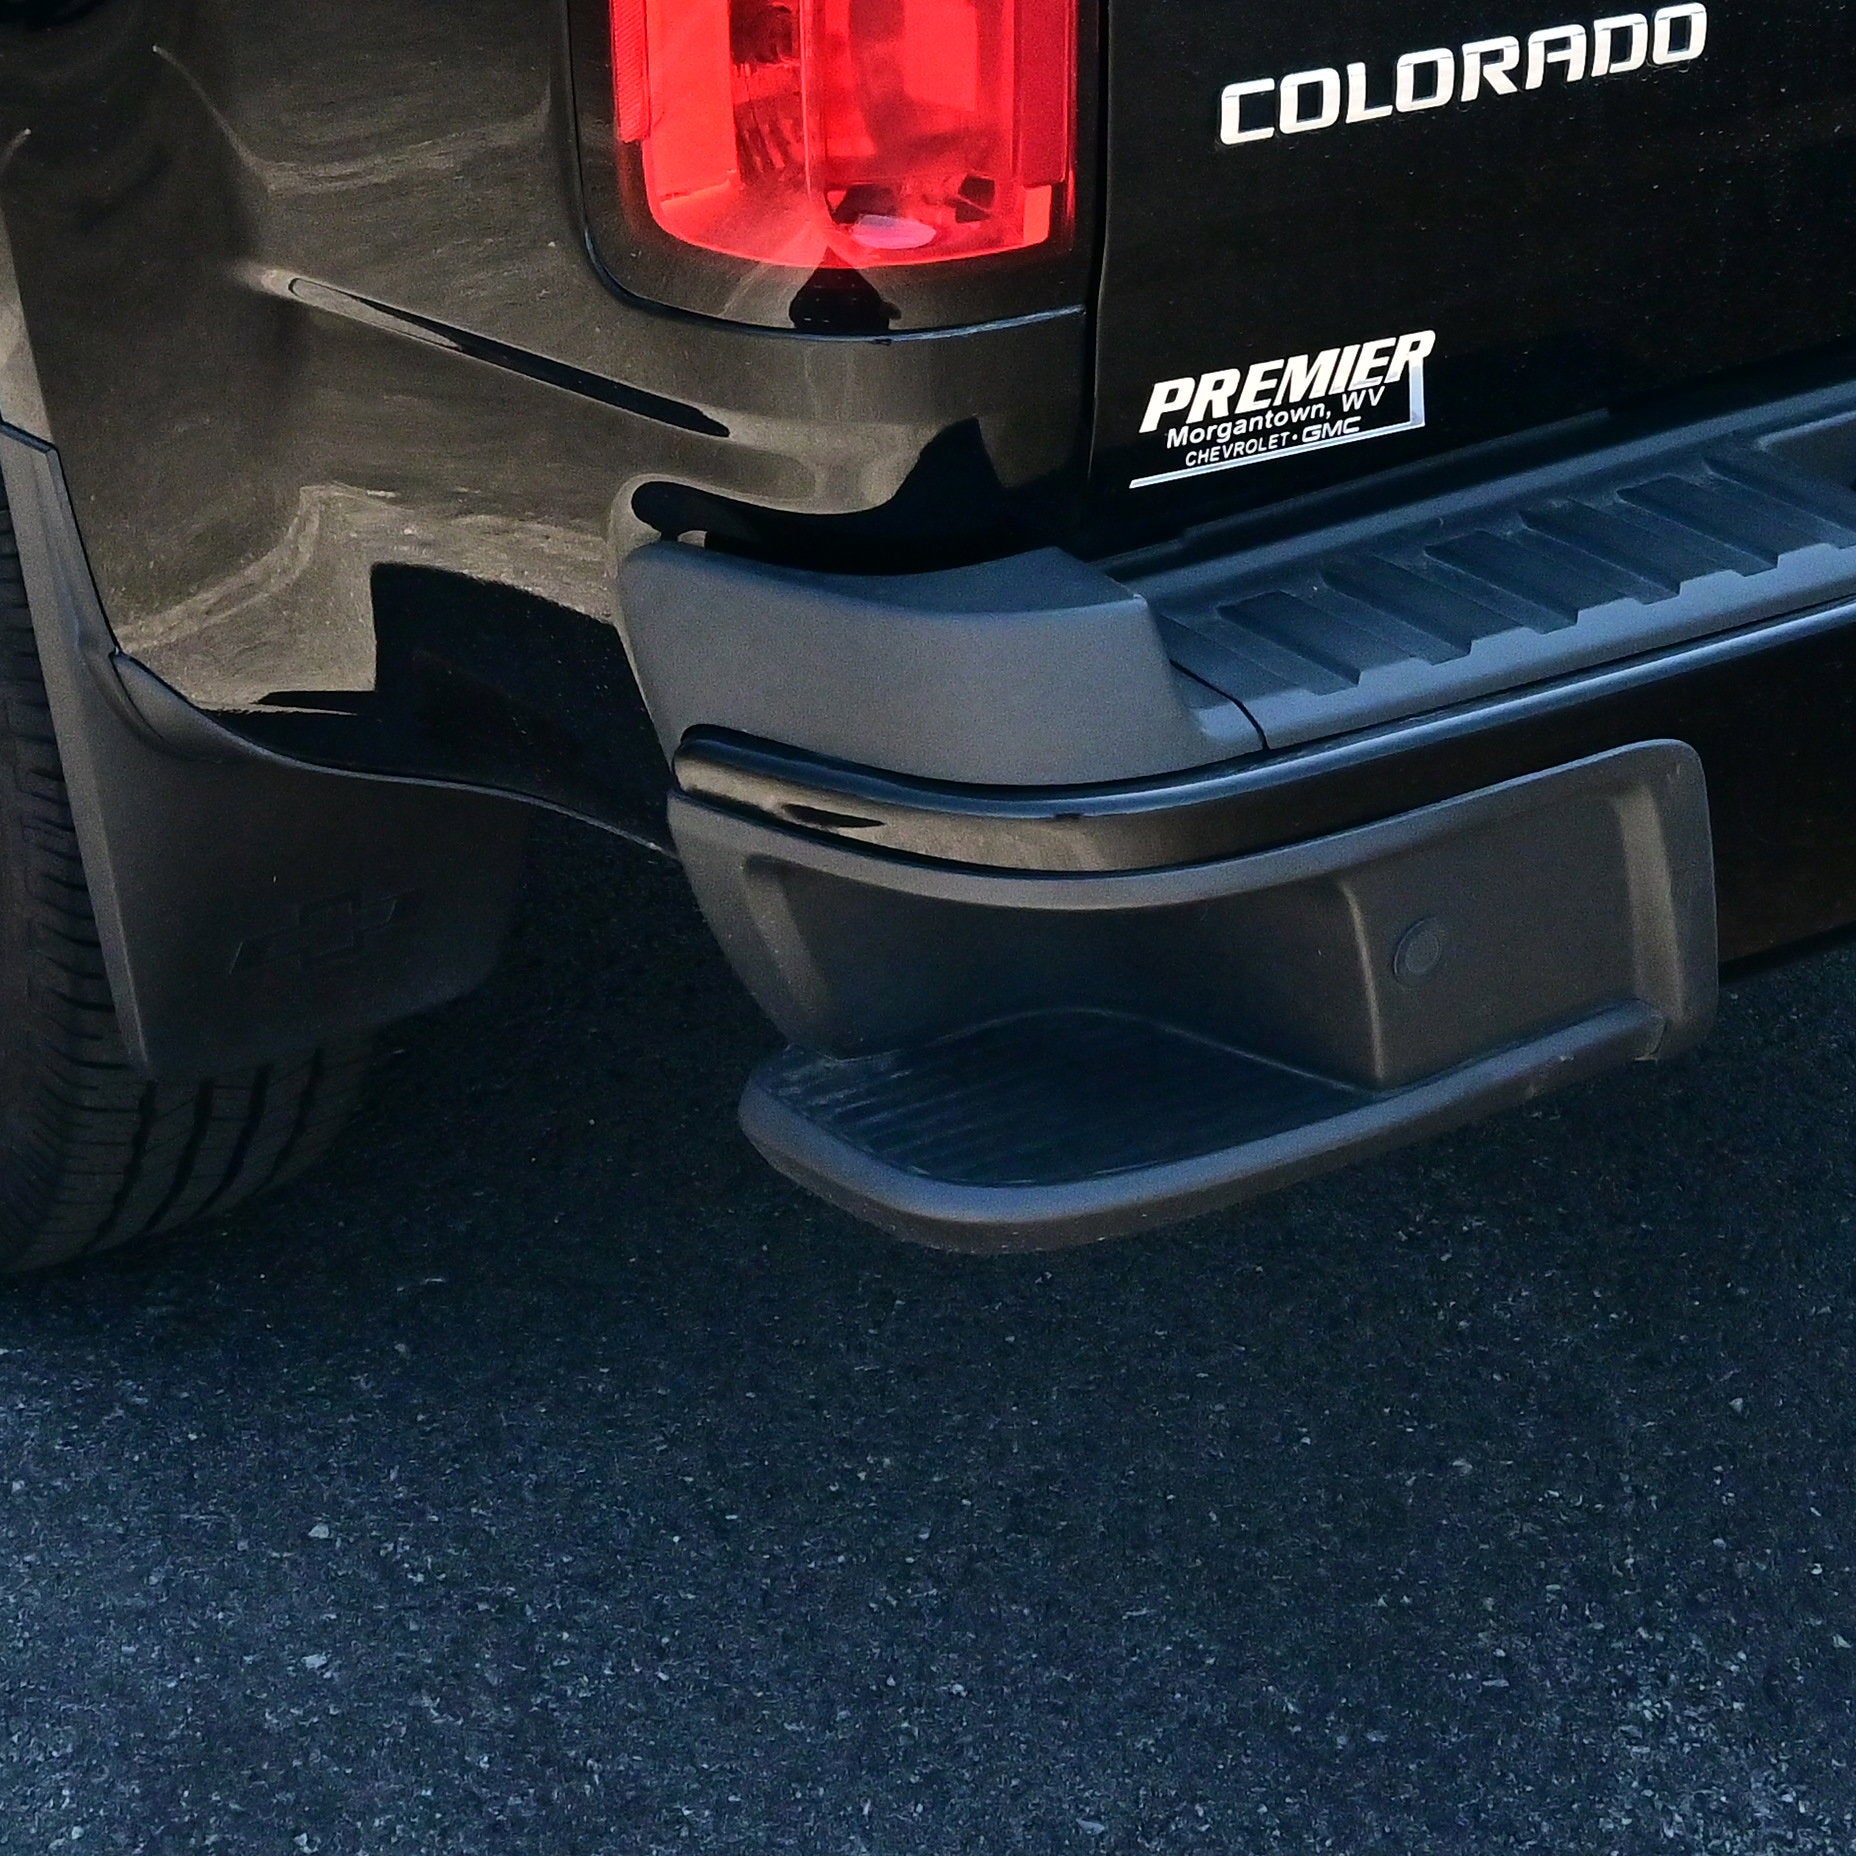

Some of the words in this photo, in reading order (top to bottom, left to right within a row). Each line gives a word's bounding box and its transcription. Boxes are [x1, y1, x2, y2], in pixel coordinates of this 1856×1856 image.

[1218, 1, 1708, 145] COLORADO
[1138, 329, 1436, 433] PREMIER
[1165, 402, 1332, 449] Morgantown,
[1342, 385, 1386, 413] WV
[1184, 432, 1288, 467] CHEVROLET
[1301, 415, 1362, 443] GMC
